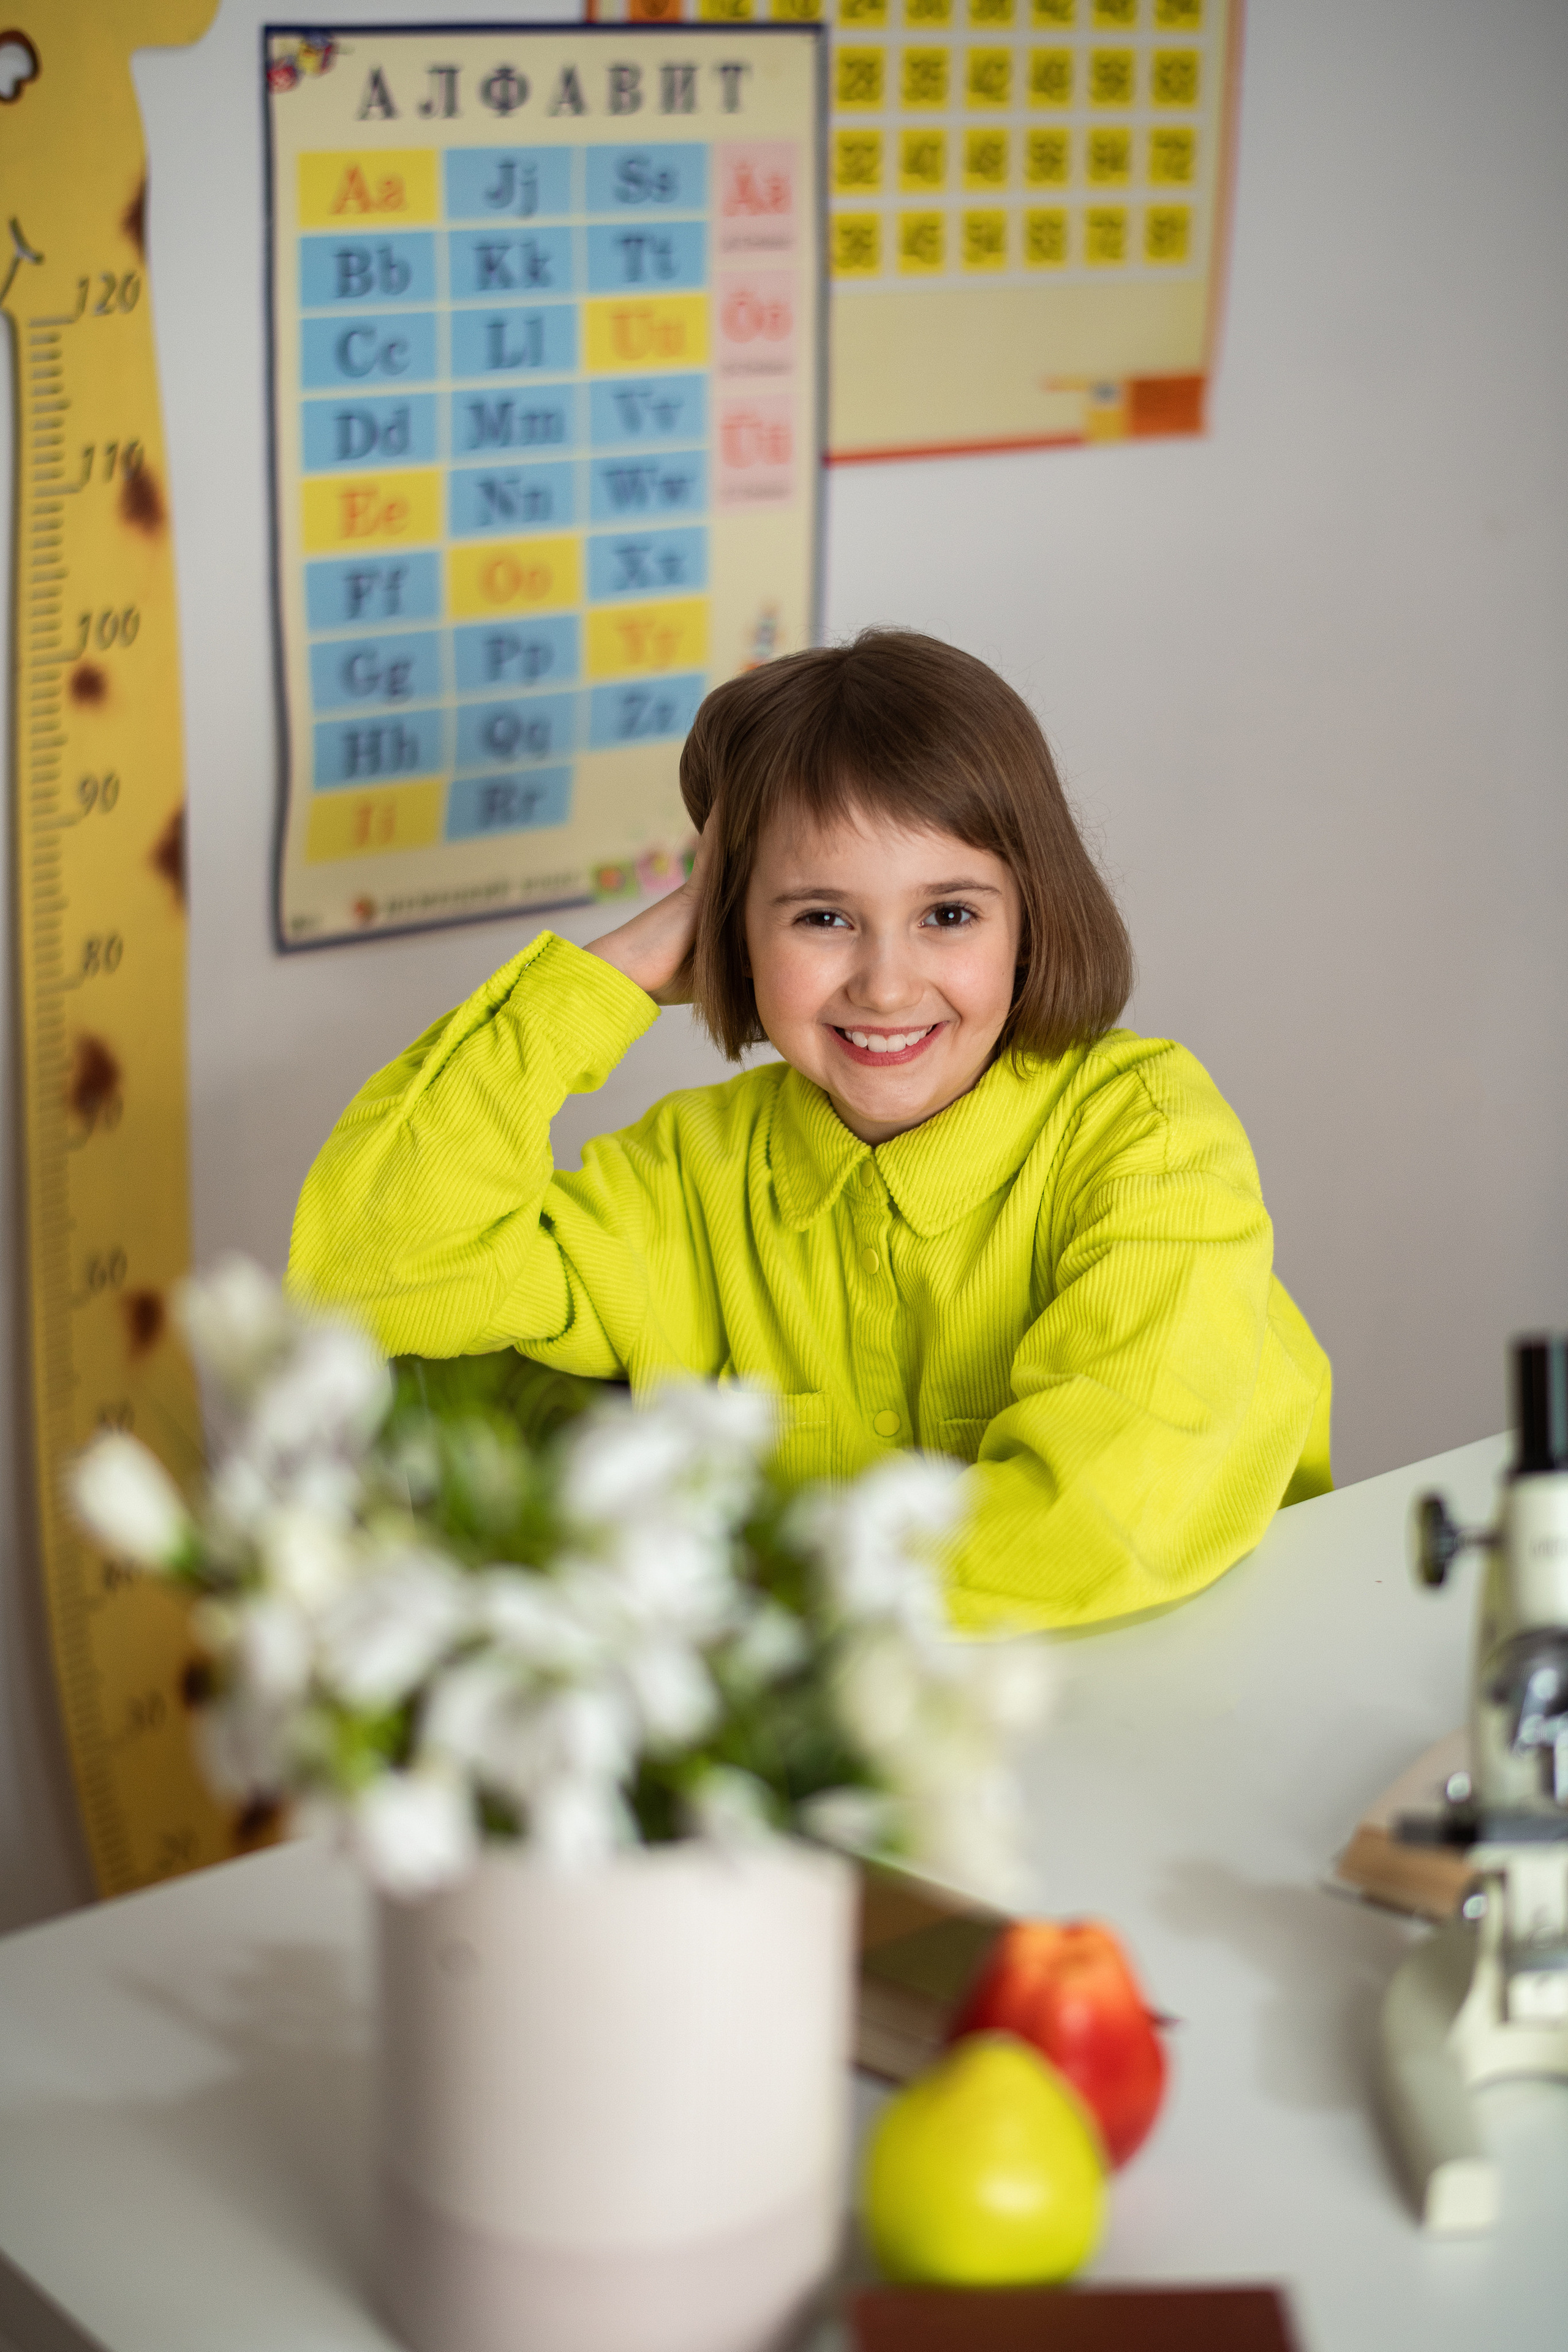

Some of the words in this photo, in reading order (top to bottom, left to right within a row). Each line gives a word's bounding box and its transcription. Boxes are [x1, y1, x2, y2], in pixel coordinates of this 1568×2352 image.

[331, 162, 404, 214] Aa
[484, 157, 538, 219] Jj
[333, 243, 412, 299] Bb
[474, 239, 551, 290] Kk
[75, 271, 141, 318] 120
[333, 323, 407, 378] Cc
[484, 315, 543, 369] Ll
[333, 404, 410, 461] Dd
[466, 396, 564, 450] Mm
[613, 386, 682, 432] Vv
[80, 437, 145, 486] 110
[337, 484, 410, 539] Ee
[77, 601, 140, 653] 100
[344, 723, 420, 779] Hh
[77, 770, 120, 816] 90
[82, 931, 123, 978] 80
